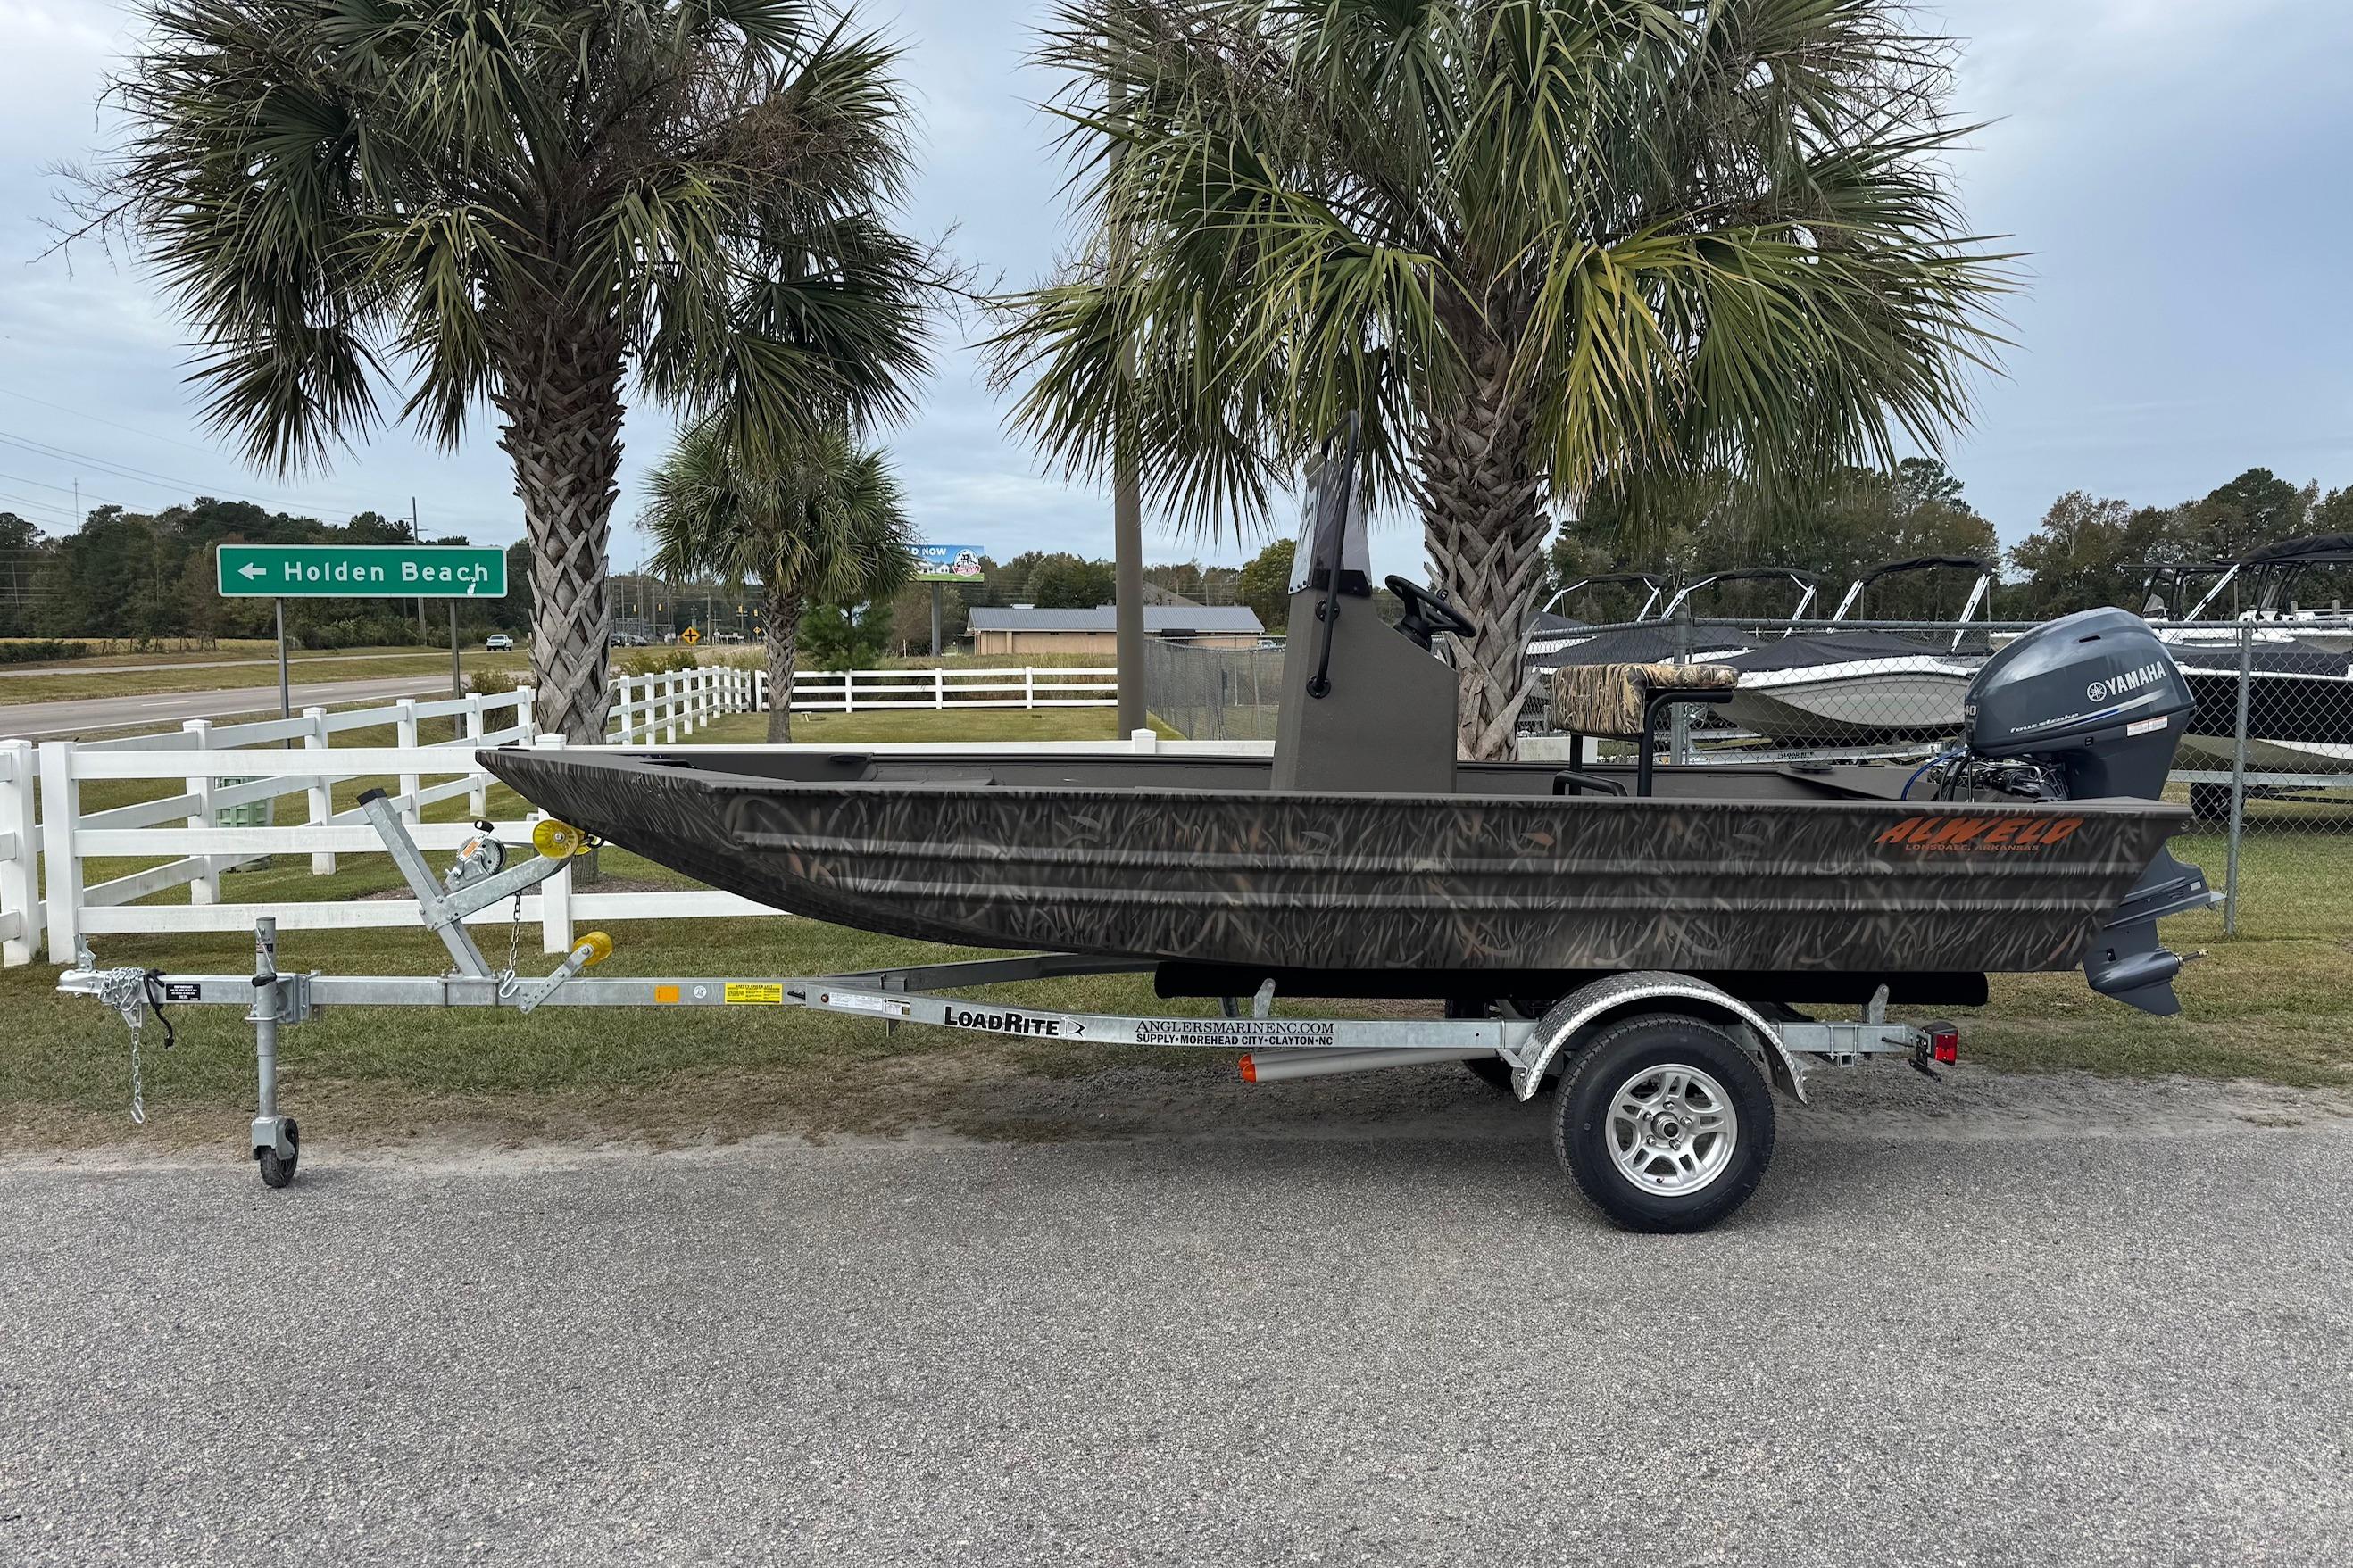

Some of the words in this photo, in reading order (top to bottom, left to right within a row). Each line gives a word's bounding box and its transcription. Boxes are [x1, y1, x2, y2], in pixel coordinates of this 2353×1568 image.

[922, 547, 946, 556] NOW
[284, 561, 385, 581] Holden
[402, 561, 488, 581] Beach
[2105, 660, 2166, 695] YAMAHA
[1874, 816, 2084, 844] ALWELD
[1974, 843, 2040, 851] ARKANSAS
[944, 1006, 1060, 1036] LOADRITE
[1135, 1020, 1334, 1034] ANGLERSMARINENC.COM
